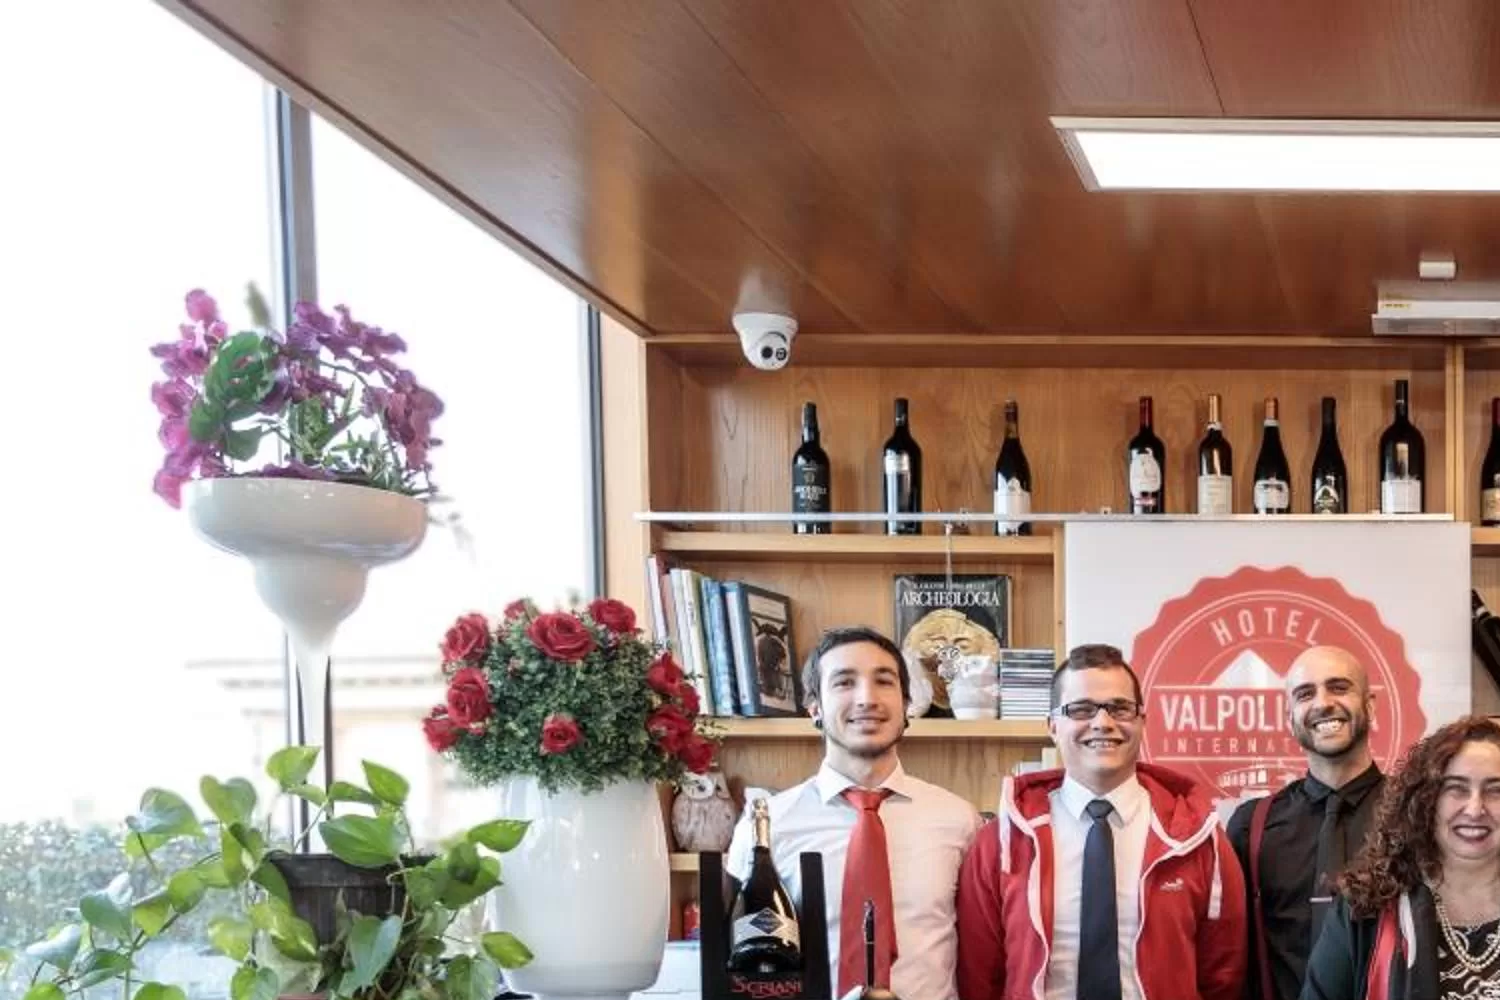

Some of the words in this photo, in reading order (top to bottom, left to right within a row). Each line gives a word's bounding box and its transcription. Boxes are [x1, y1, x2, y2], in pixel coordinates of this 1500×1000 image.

[901, 591, 1000, 607] ARCHEOLOGIA
[1210, 607, 1323, 647] HOTEL
[1160, 694, 1379, 732] VALPOLI
